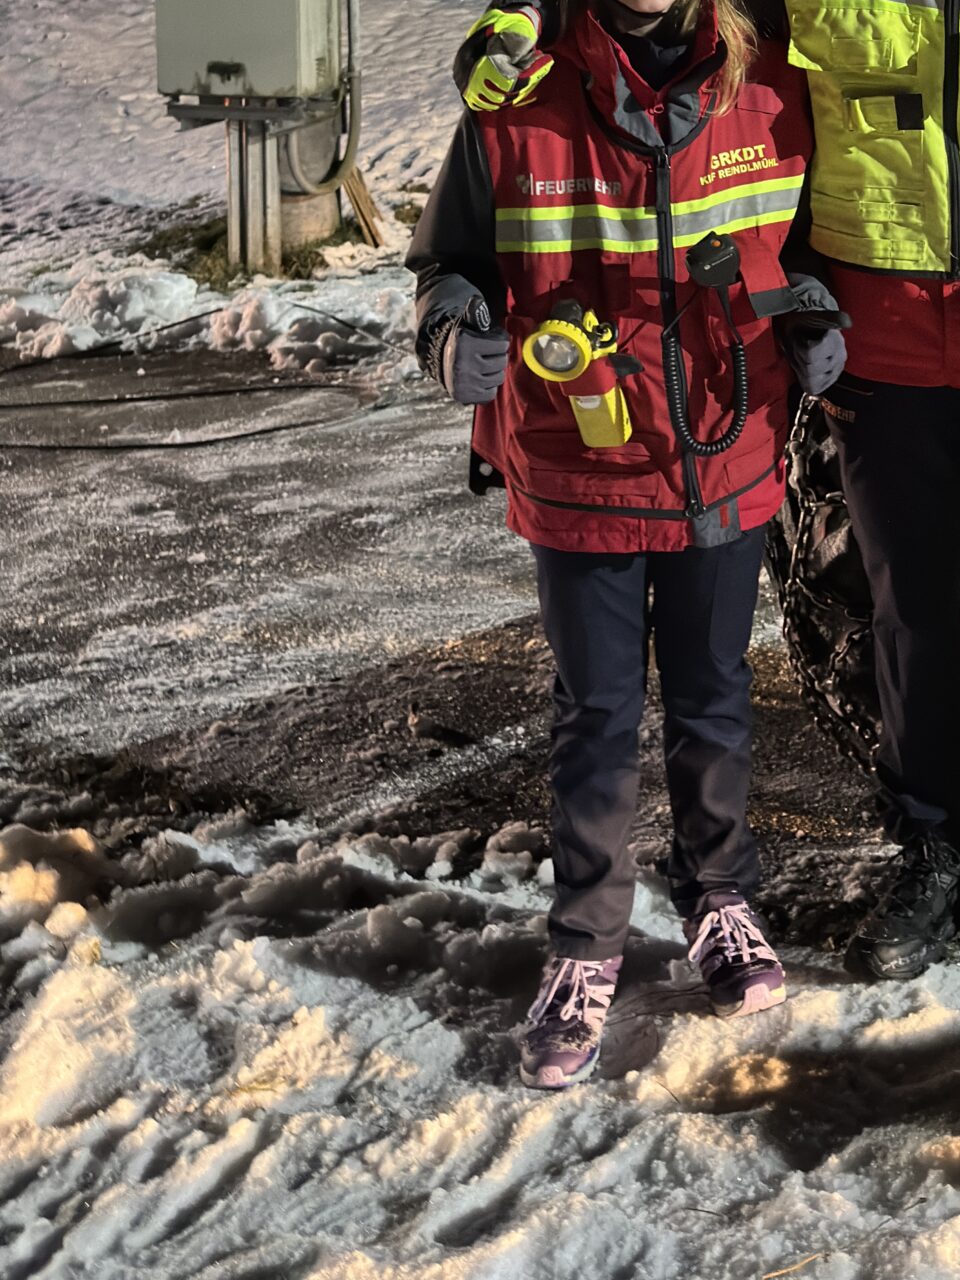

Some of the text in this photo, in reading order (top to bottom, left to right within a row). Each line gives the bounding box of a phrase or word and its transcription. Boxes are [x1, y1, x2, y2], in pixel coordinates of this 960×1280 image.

[710, 144, 766, 170] GRKDT
[718, 158, 779, 179] REINDLMÜHL
[535, 176, 621, 197] FEUERWEHR
